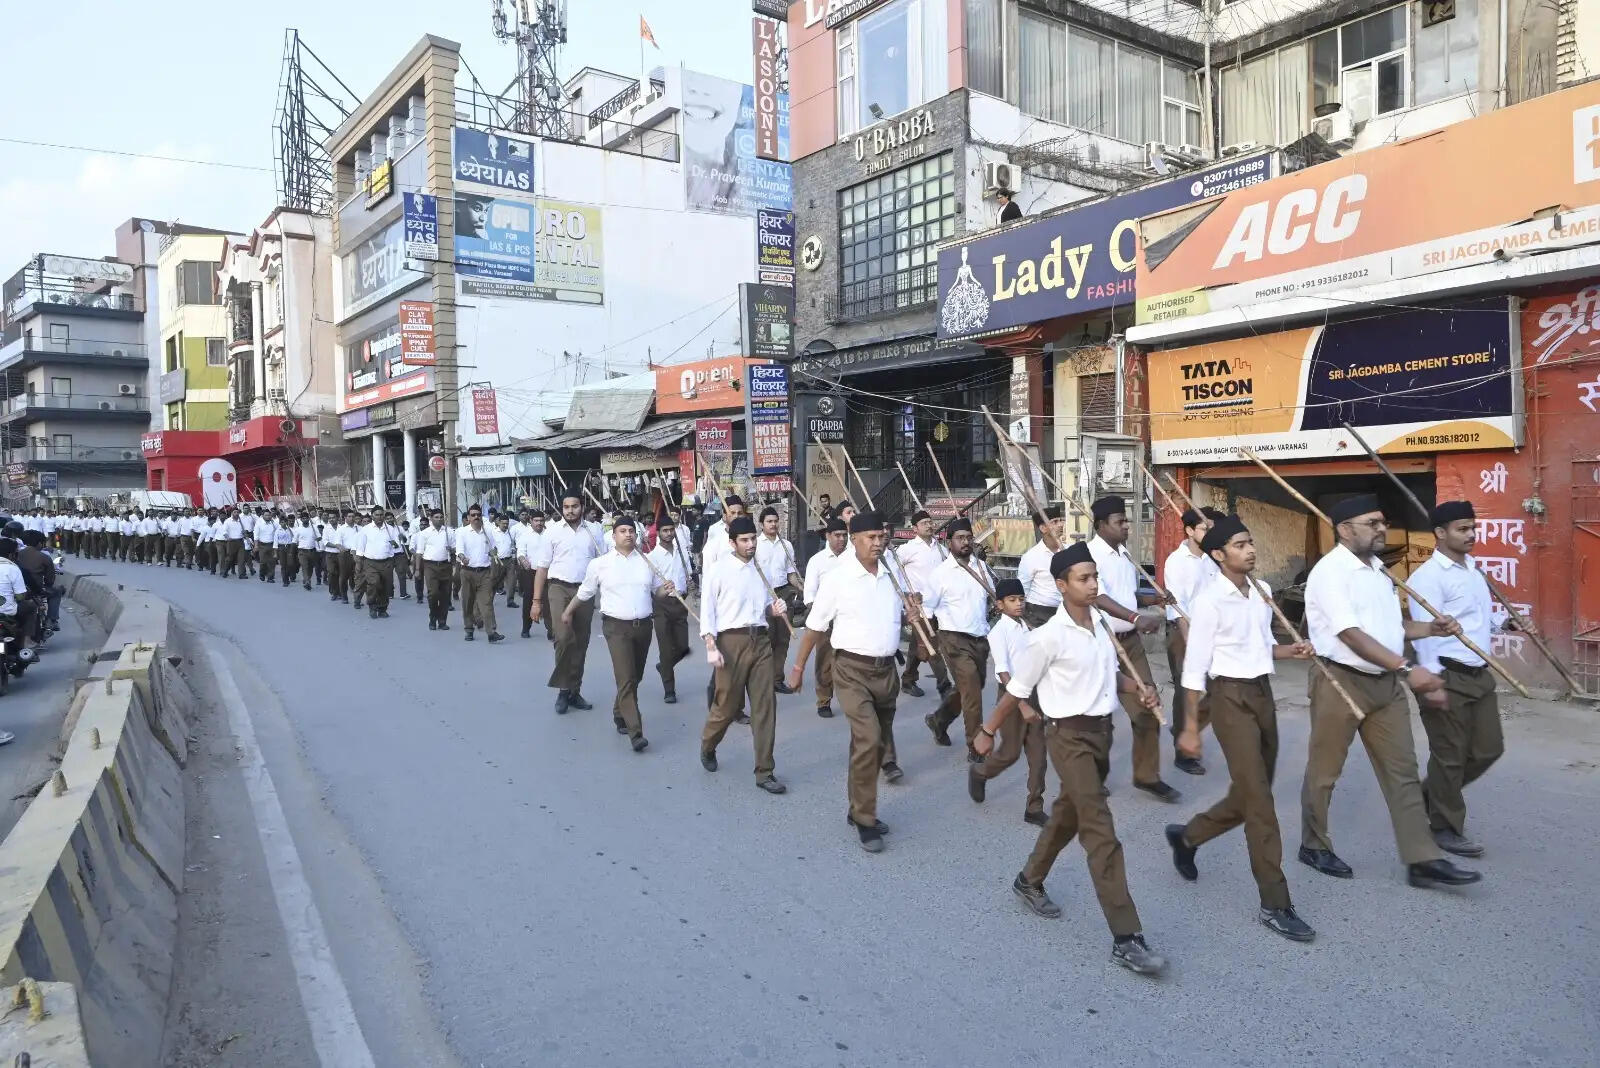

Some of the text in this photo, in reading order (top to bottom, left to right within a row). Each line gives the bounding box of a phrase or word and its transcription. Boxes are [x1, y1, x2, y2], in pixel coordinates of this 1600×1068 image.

[855, 110, 936, 162] O'BARBA
[738, 159, 790, 179] DENTAL
[866, 143, 924, 176] FAMILY SALON
[498, 168, 530, 190] IAS
[692, 165, 790, 192] Dr. Praveen Kumar
[1203, 160, 1265, 185] 9307119889
[1203, 174, 1265, 197] 8273461555
[1211, 174, 1368, 271] ACC
[408, 231, 436, 244] IAS
[505, 232, 518, 240] FOR
[1422, 218, 1600, 267] SRI JAGDAMBA CEME
[489, 241, 531, 256] IAS & PCS
[536, 240, 600, 269] ENTAL
[992, 236, 1093, 302] Lady
[1087, 279, 1137, 300] FASHI
[1255, 285, 1281, 298] PHONE
[1282, 283, 1295, 293] NO
[1301, 279, 1315, 290] +91
[1317, 269, 1369, 286] 9336182012
[1146, 295, 1195, 313] AUTHORISED
[1154, 307, 1187, 322] RETAILER
[873, 344, 900, 359] make
[903, 342, 931, 358] your
[1181, 359, 1231, 380] TATA
[1328, 351, 1490, 381] SRI JAGDAMBA CEMENT STORE
[1181, 378, 1253, 401] TISCON
[810, 419, 844, 432] O'BARBA
[1183, 411, 1198, 422] JOY
[1213, 408, 1254, 419] BUILDING
[754, 424, 788, 436] HOTEL
[1405, 433, 1480, 446] PH.NO.9336182012
[755, 436, 789, 448] KASHI
[1213, 447, 1229, 455] BAGH
[1277, 442, 1308, 451] VARANASI
[1479, 462, 1509, 494] श्री
